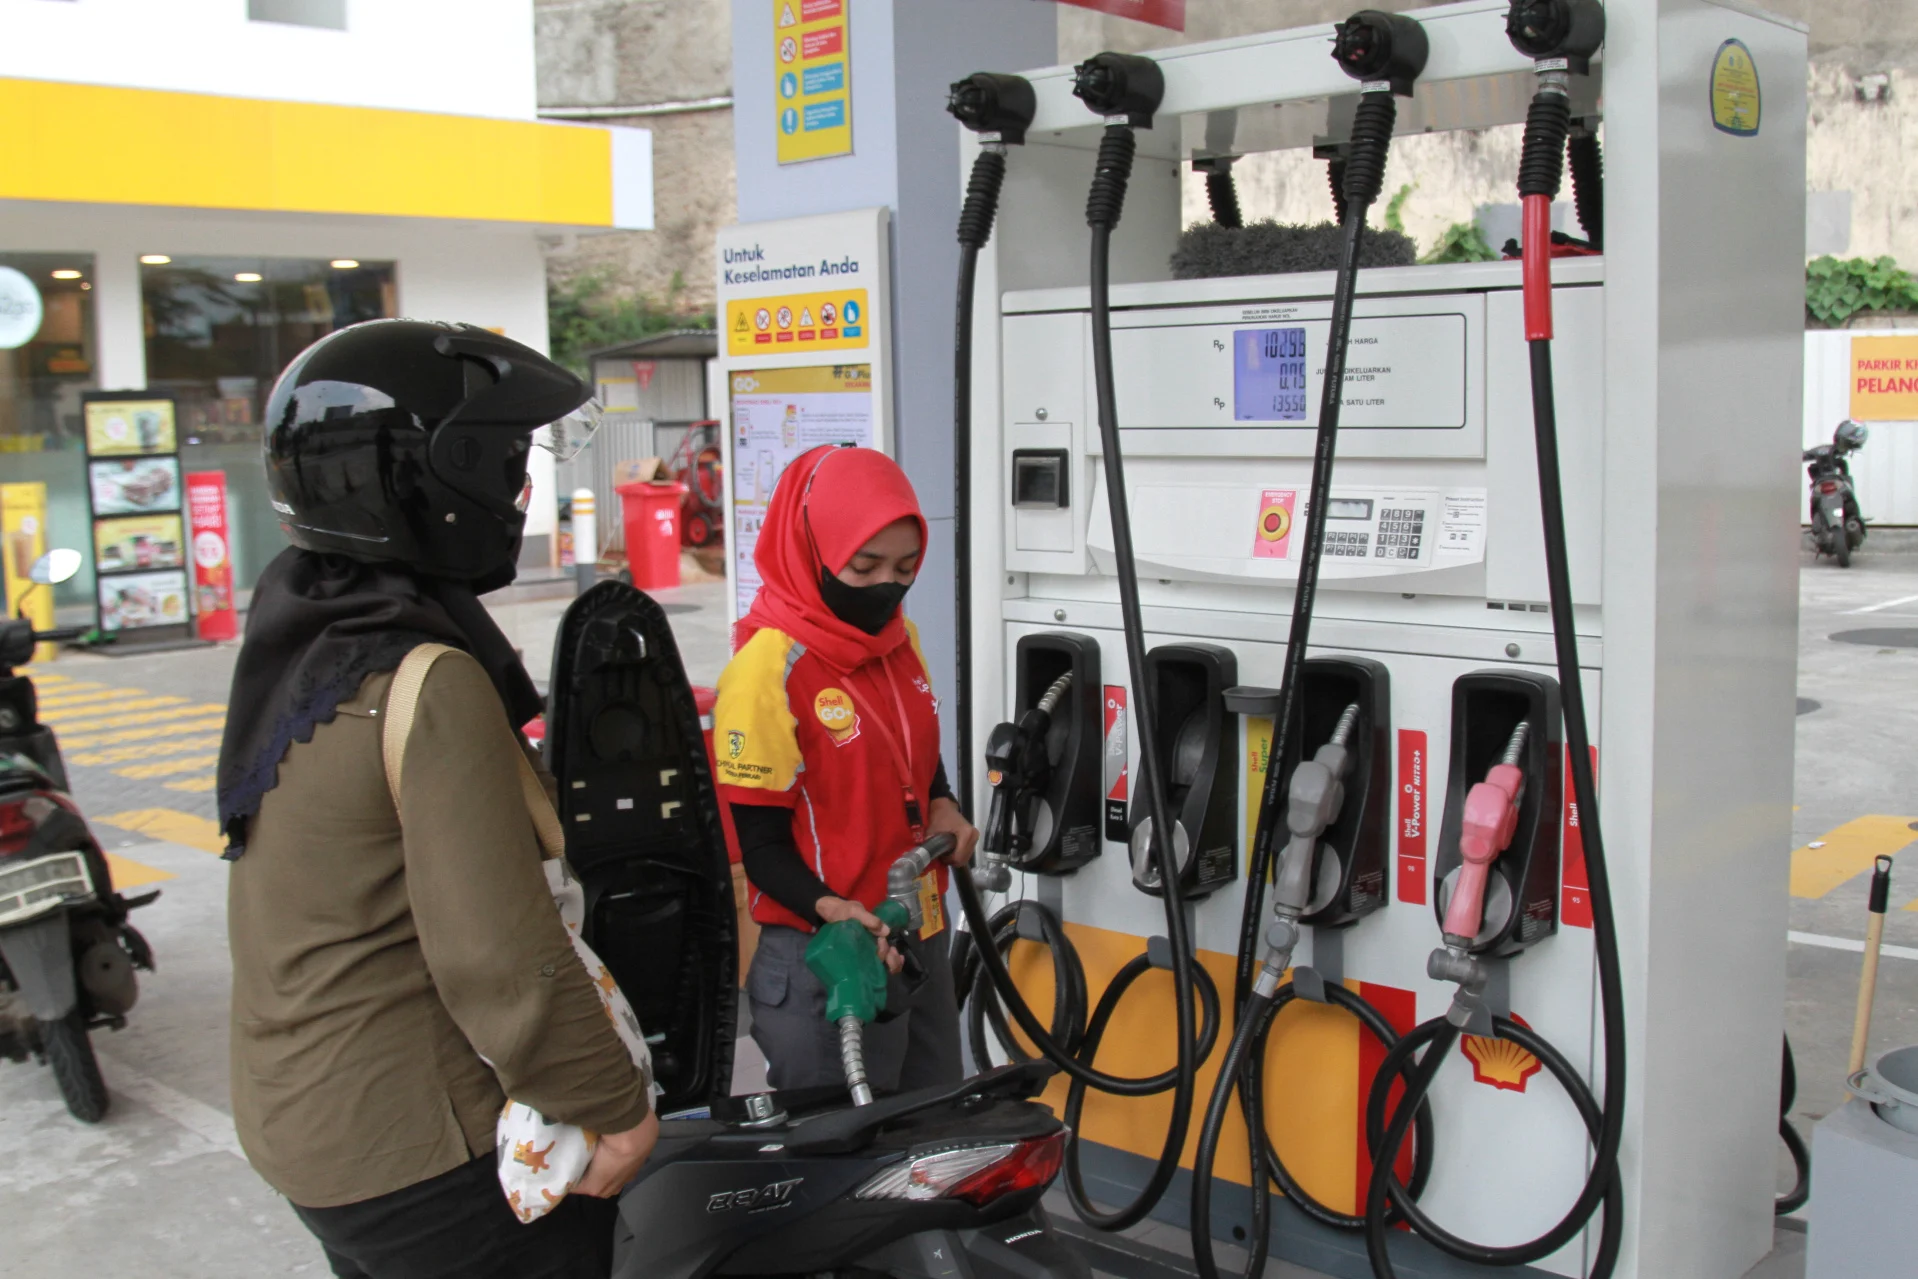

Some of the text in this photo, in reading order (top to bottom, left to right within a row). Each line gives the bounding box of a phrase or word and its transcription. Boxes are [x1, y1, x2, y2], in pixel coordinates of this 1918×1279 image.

[724, 244, 764, 263] Untuk
[725, 256, 859, 284] Keselamatan Anda
[1214, 340, 1224, 352] Rp
[1858, 360, 1901, 370] PARKIR
[1214, 398, 1225, 410] Rp
[819, 696, 844, 706] Shell
[822, 707, 852, 720] GO+
[1259, 737, 1269, 774] Super
[738, 763, 773, 774] PARTNER
[1411, 789, 1421, 838] V-Power
[1569, 802, 1578, 827] Shell
[706, 1177, 804, 1213] BEAT
[1004, 1229, 1044, 1244] HONDA
